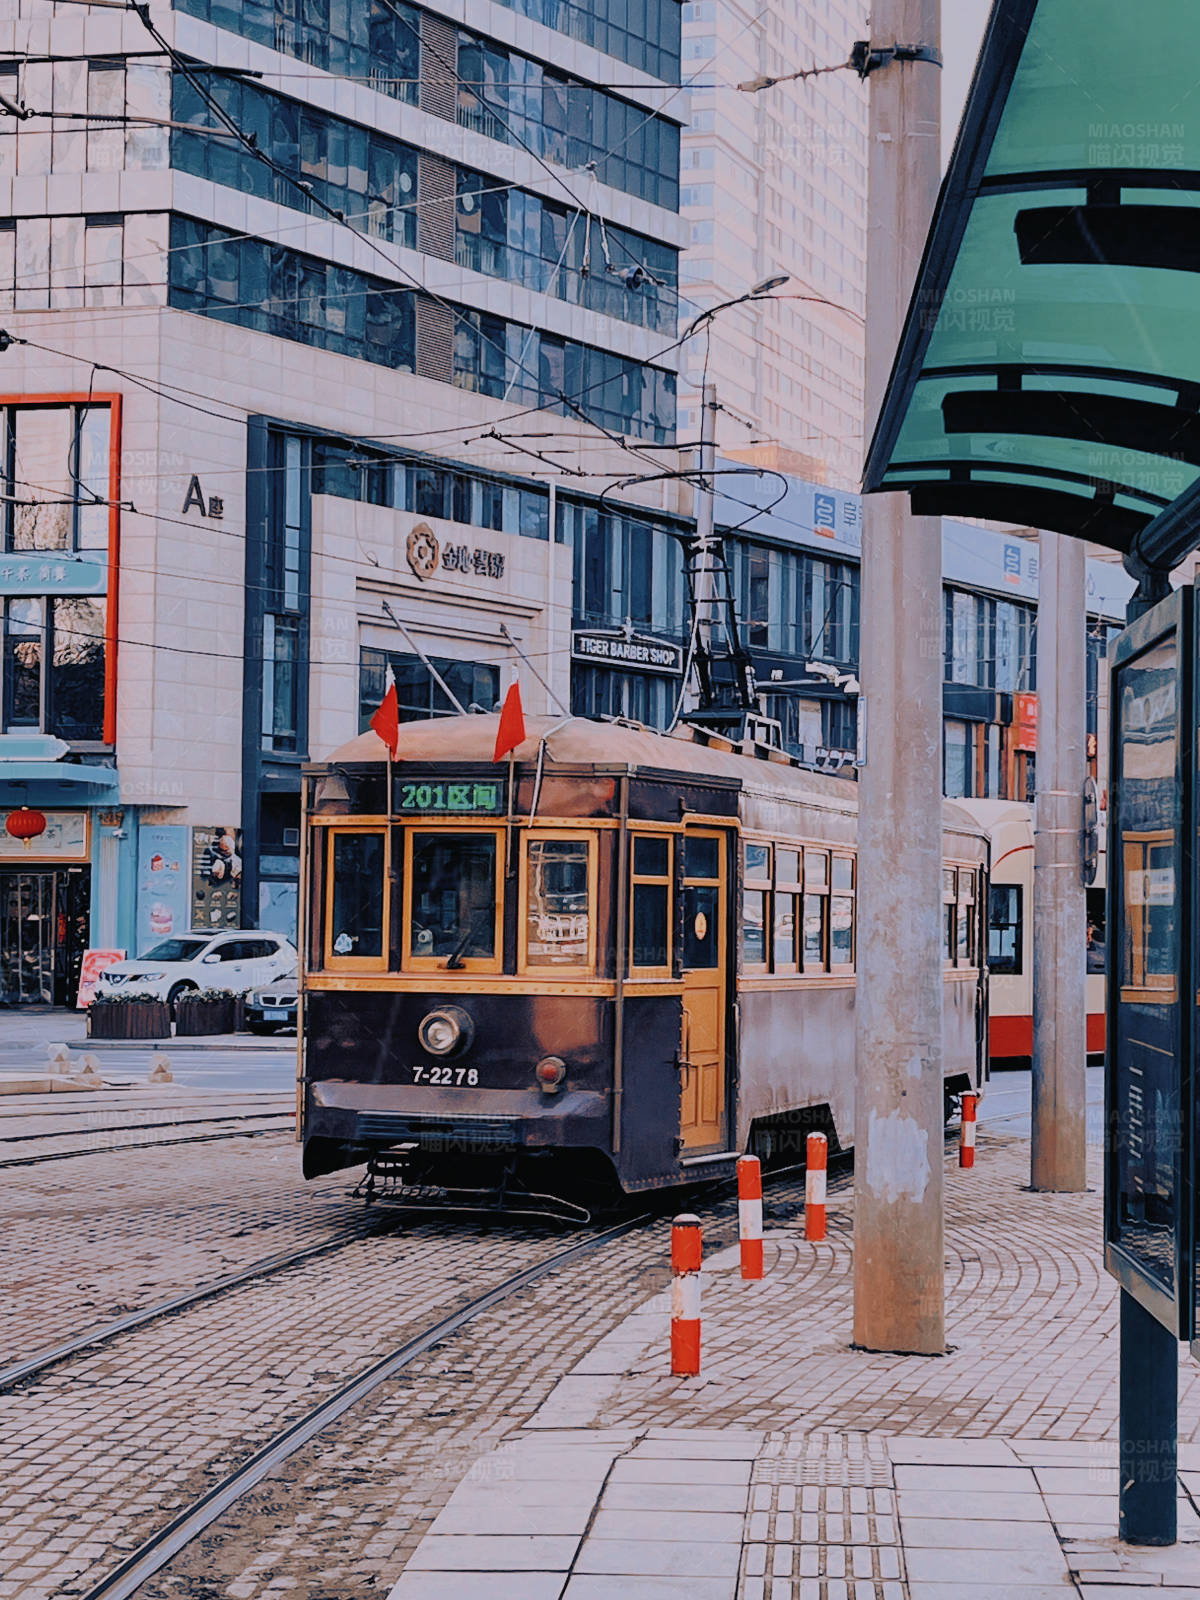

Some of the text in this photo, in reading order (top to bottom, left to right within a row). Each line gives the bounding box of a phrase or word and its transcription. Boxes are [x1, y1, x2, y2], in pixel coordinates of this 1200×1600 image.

[579, 637, 676, 666] TIGER BARBER SHOP
[402, 783, 497, 811] 201区间
[412, 1066, 479, 1086] 7-2278
